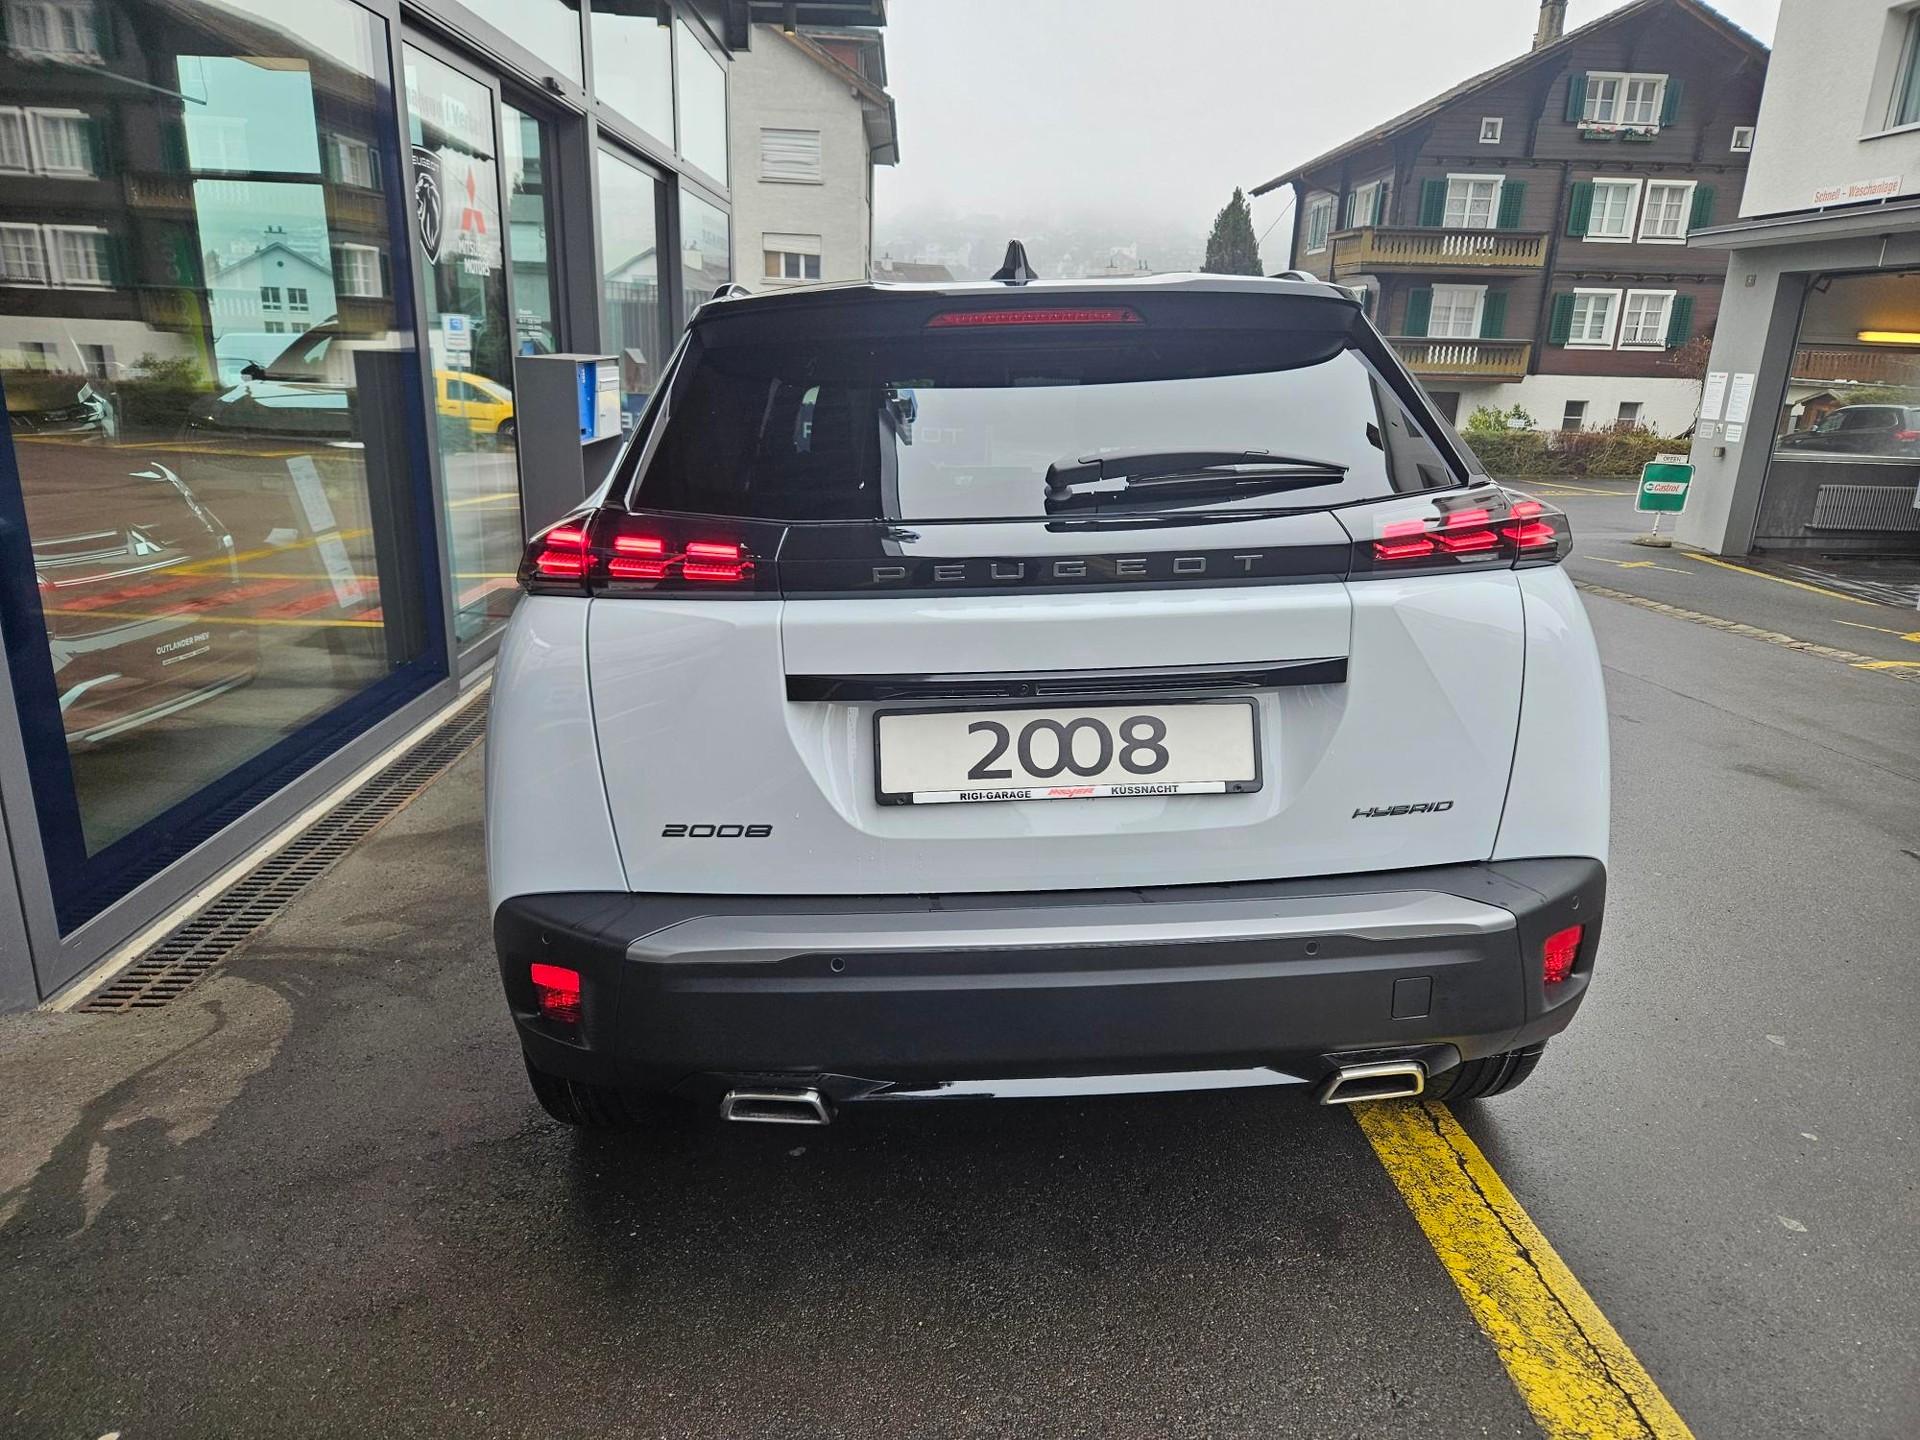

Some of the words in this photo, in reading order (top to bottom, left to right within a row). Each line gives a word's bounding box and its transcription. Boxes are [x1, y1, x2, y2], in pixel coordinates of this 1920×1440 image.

[412, 155, 440, 172] EUGEOT
[1814, 188, 1841, 203] Schnell
[1848, 180, 1899, 198] Waschanlage
[464, 258, 490, 276] MOTORS
[1654, 483, 1680, 492] Castrol
[872, 554, 1264, 583] PEUGEOT
[156, 637, 193, 655] OUTLANDER
[194, 632, 210, 642] PHEV
[967, 715, 1170, 780] 2008
[959, 790, 1032, 801] RIGI-GARAGE
[1111, 784, 1179, 795] KÜSSNACHT
[1351, 800, 1454, 819] HYBRID
[661, 824, 773, 838] 2008
